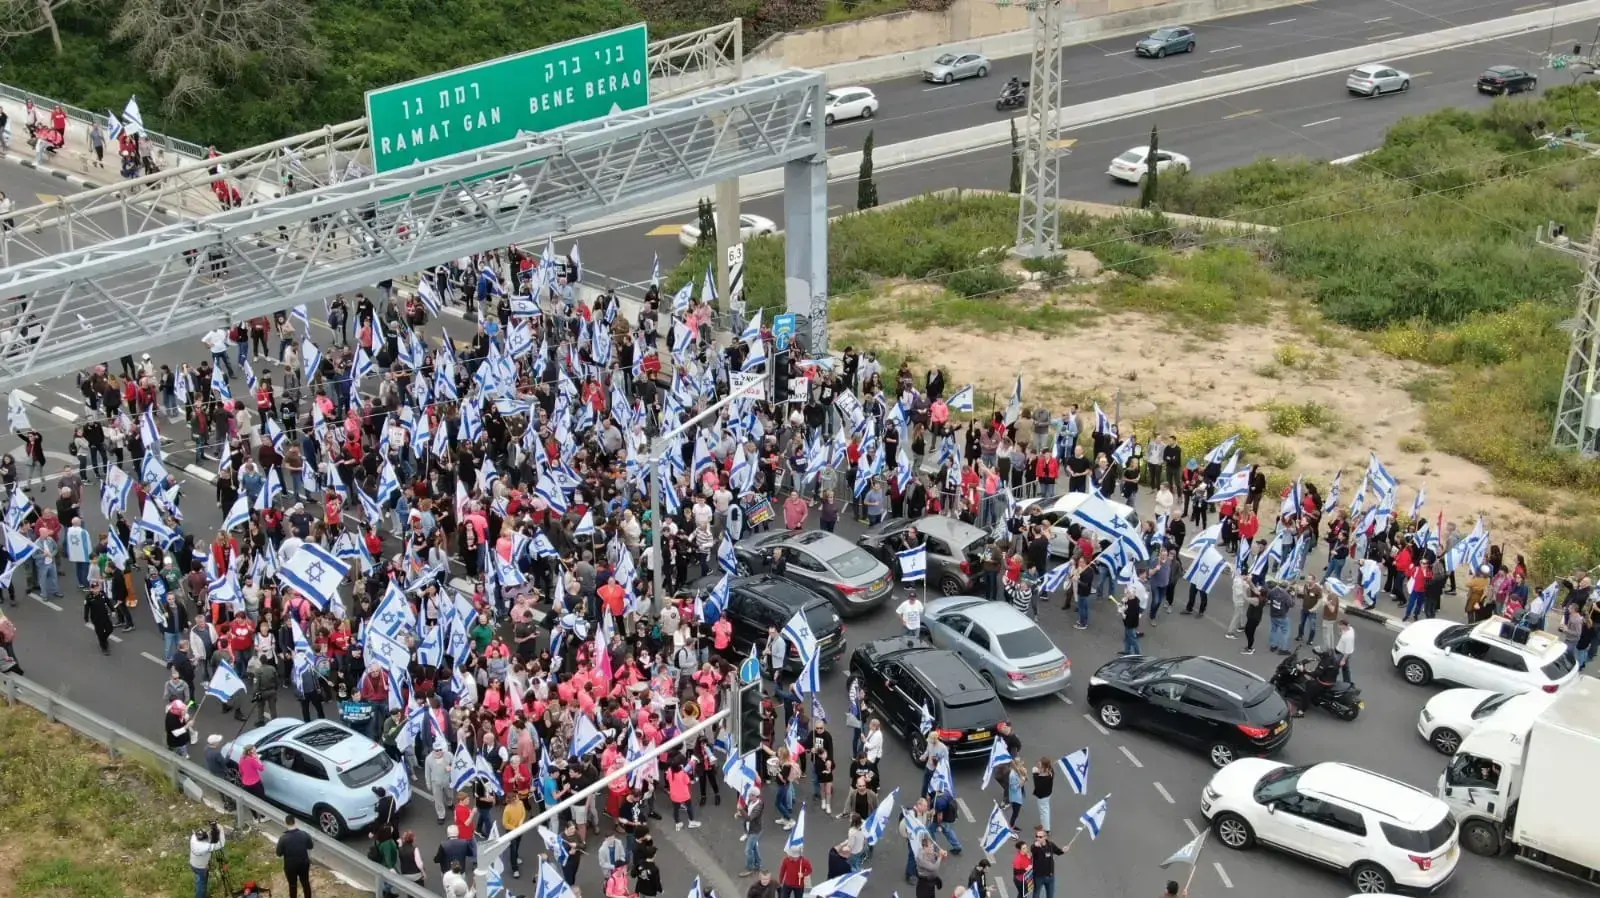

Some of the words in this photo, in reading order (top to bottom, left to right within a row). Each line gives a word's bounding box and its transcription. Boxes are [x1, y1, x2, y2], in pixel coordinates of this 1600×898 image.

[595, 44, 624, 65] בני
[544, 56, 581, 83] ברק
[402, 97, 424, 120] גן
[439, 82, 480, 109] רמת
[529, 86, 575, 114] BENE
[381, 120, 450, 155] RAMAT
[463, 106, 501, 132] GAN
[728, 247, 742, 262] 6.3
